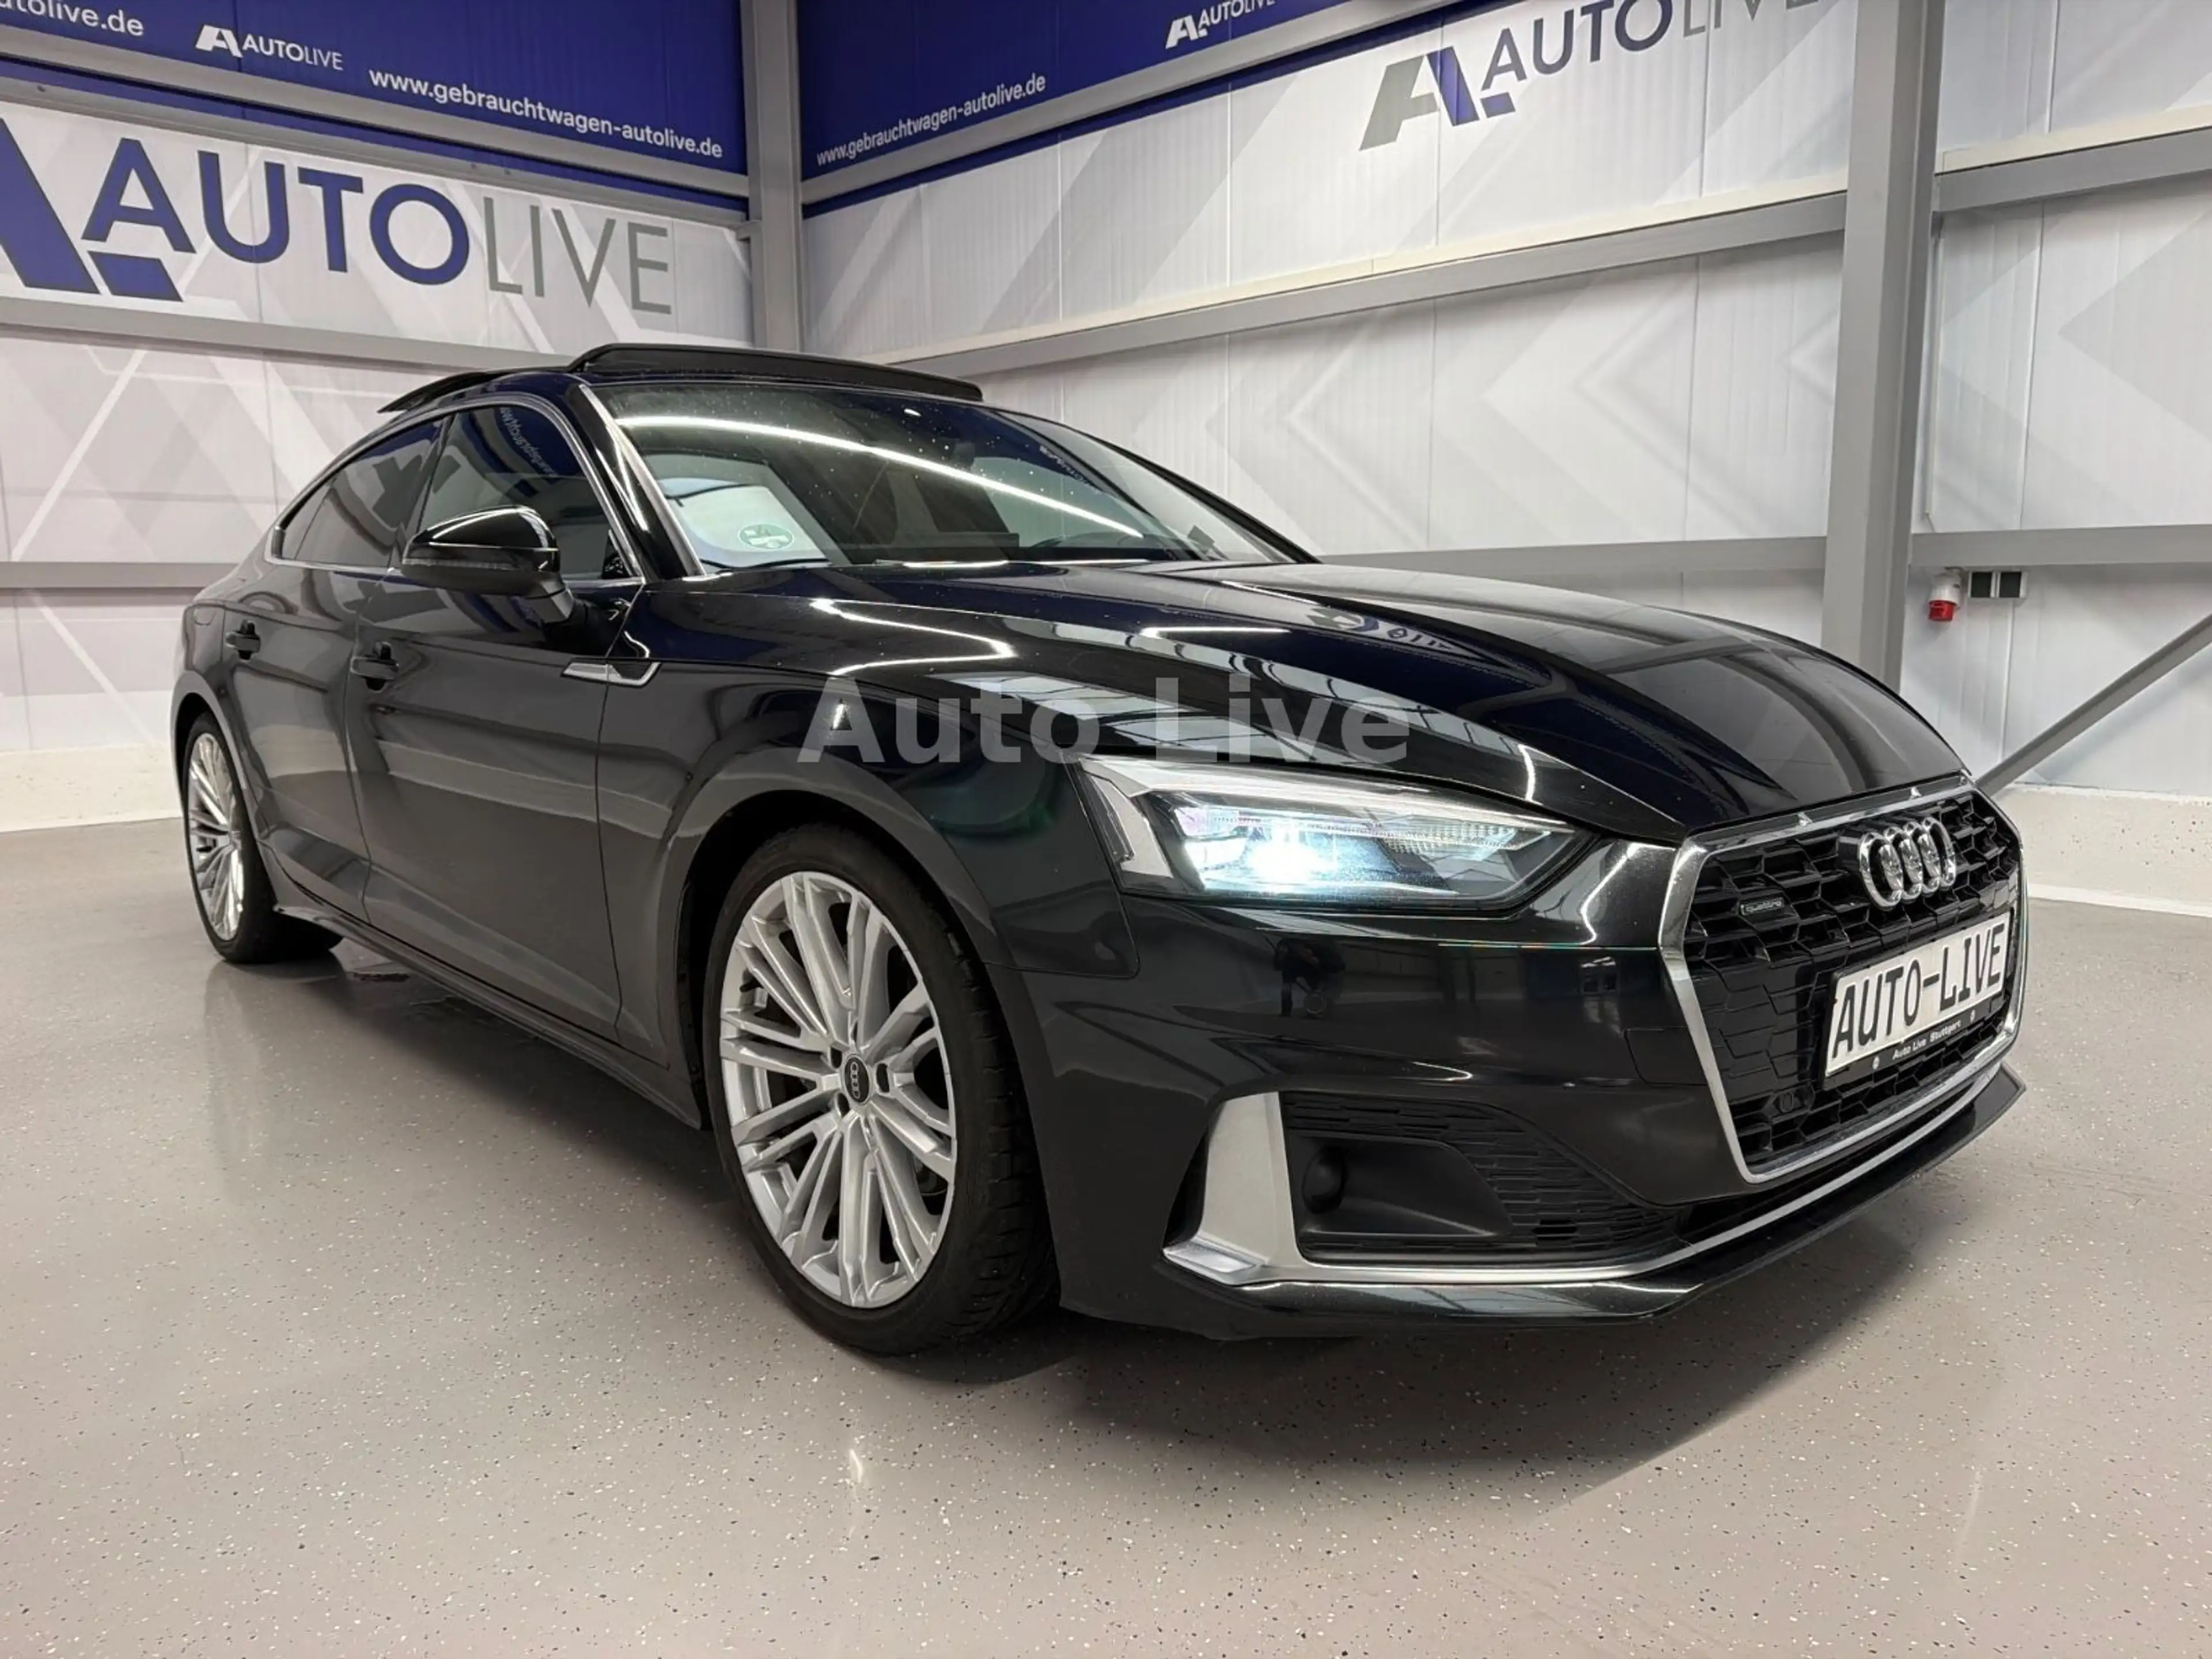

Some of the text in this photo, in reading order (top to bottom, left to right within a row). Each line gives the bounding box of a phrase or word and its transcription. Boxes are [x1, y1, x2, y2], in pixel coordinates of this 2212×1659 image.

[243, 33, 343, 71] AUTOLIVE
[369, 69, 723, 159] www.gebrauchtwagen-autolive.de
[817, 74, 1047, 166] www.gebrauchtwagen-autolive.de
[81, 137, 671, 315] AUTOLIVE
[1832, 922, 2005, 1058] AUTO-LIVE
